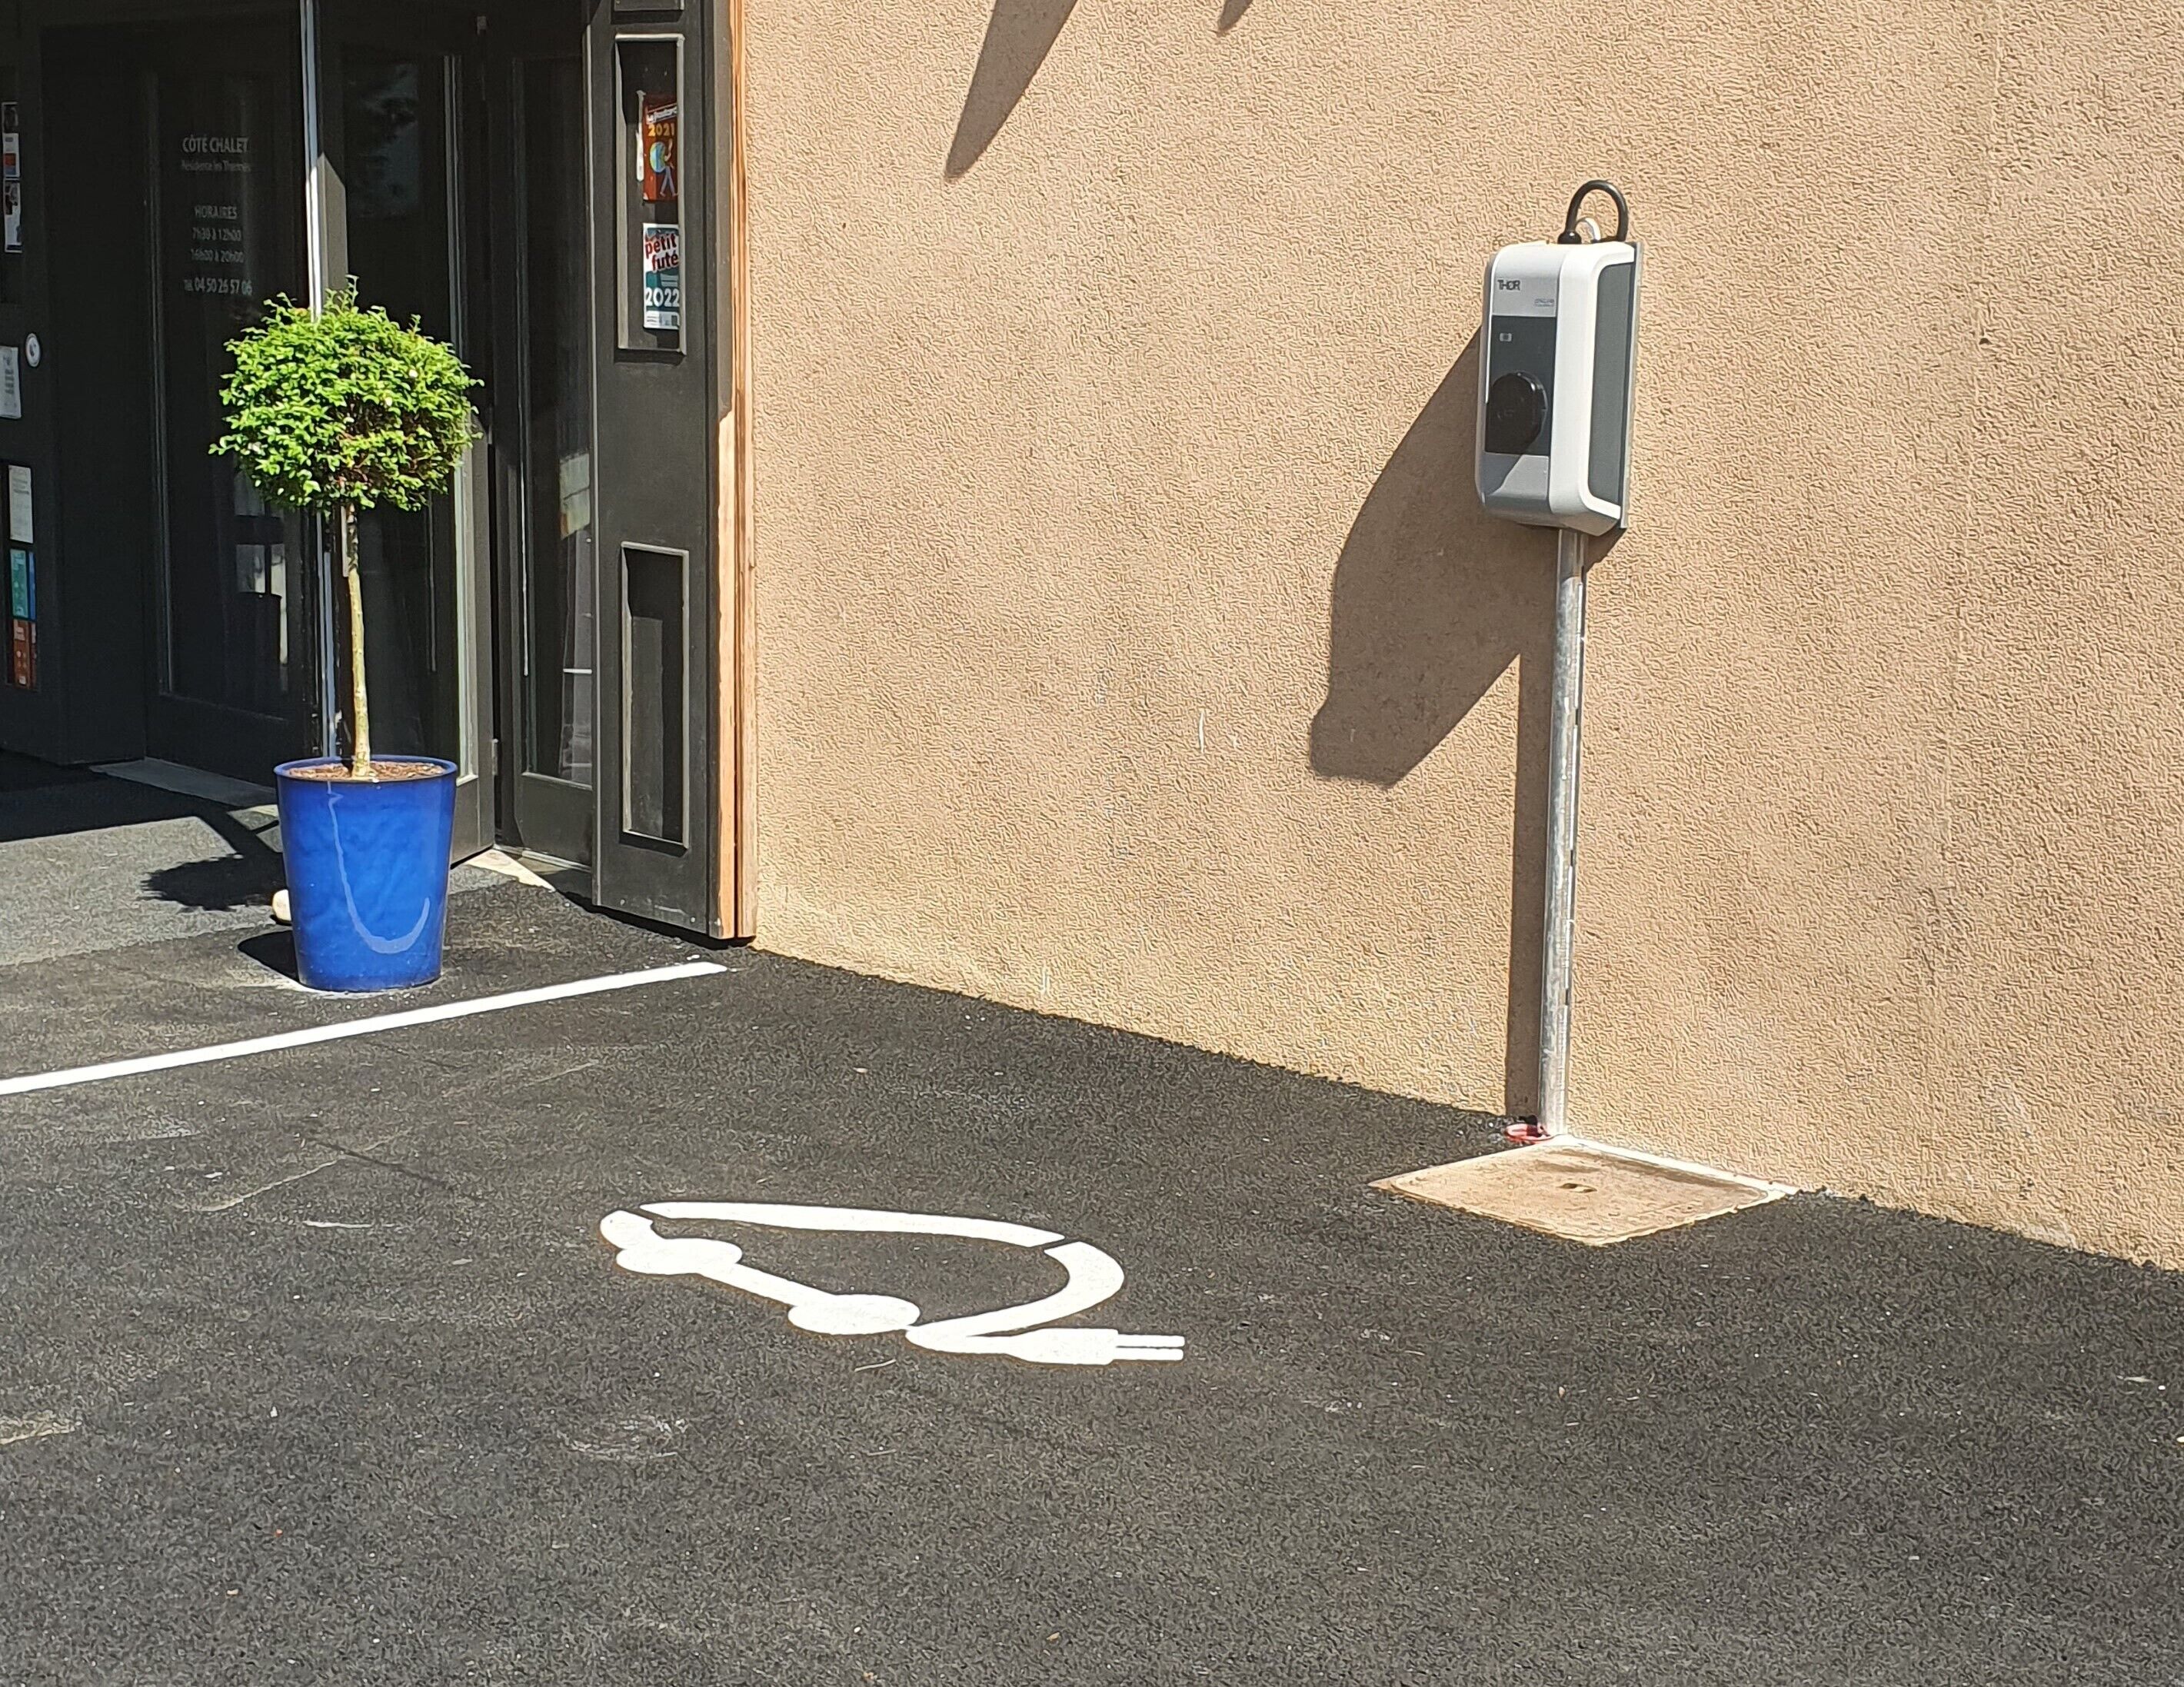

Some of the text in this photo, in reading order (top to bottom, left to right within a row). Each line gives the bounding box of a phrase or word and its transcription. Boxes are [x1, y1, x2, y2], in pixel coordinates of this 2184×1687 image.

[648, 122, 675, 137] 2021
[181, 135, 248, 153] CÔTÉ CHALET
[195, 205, 237, 219] HORAIRES
[645, 232, 677, 259] petit
[651, 250, 679, 271] futé
[194, 277, 205, 294] 04
[206, 278, 217, 293] 50
[230, 278, 240, 294] 57
[1497, 279, 1520, 291] THOR
[645, 287, 680, 307] 2022
